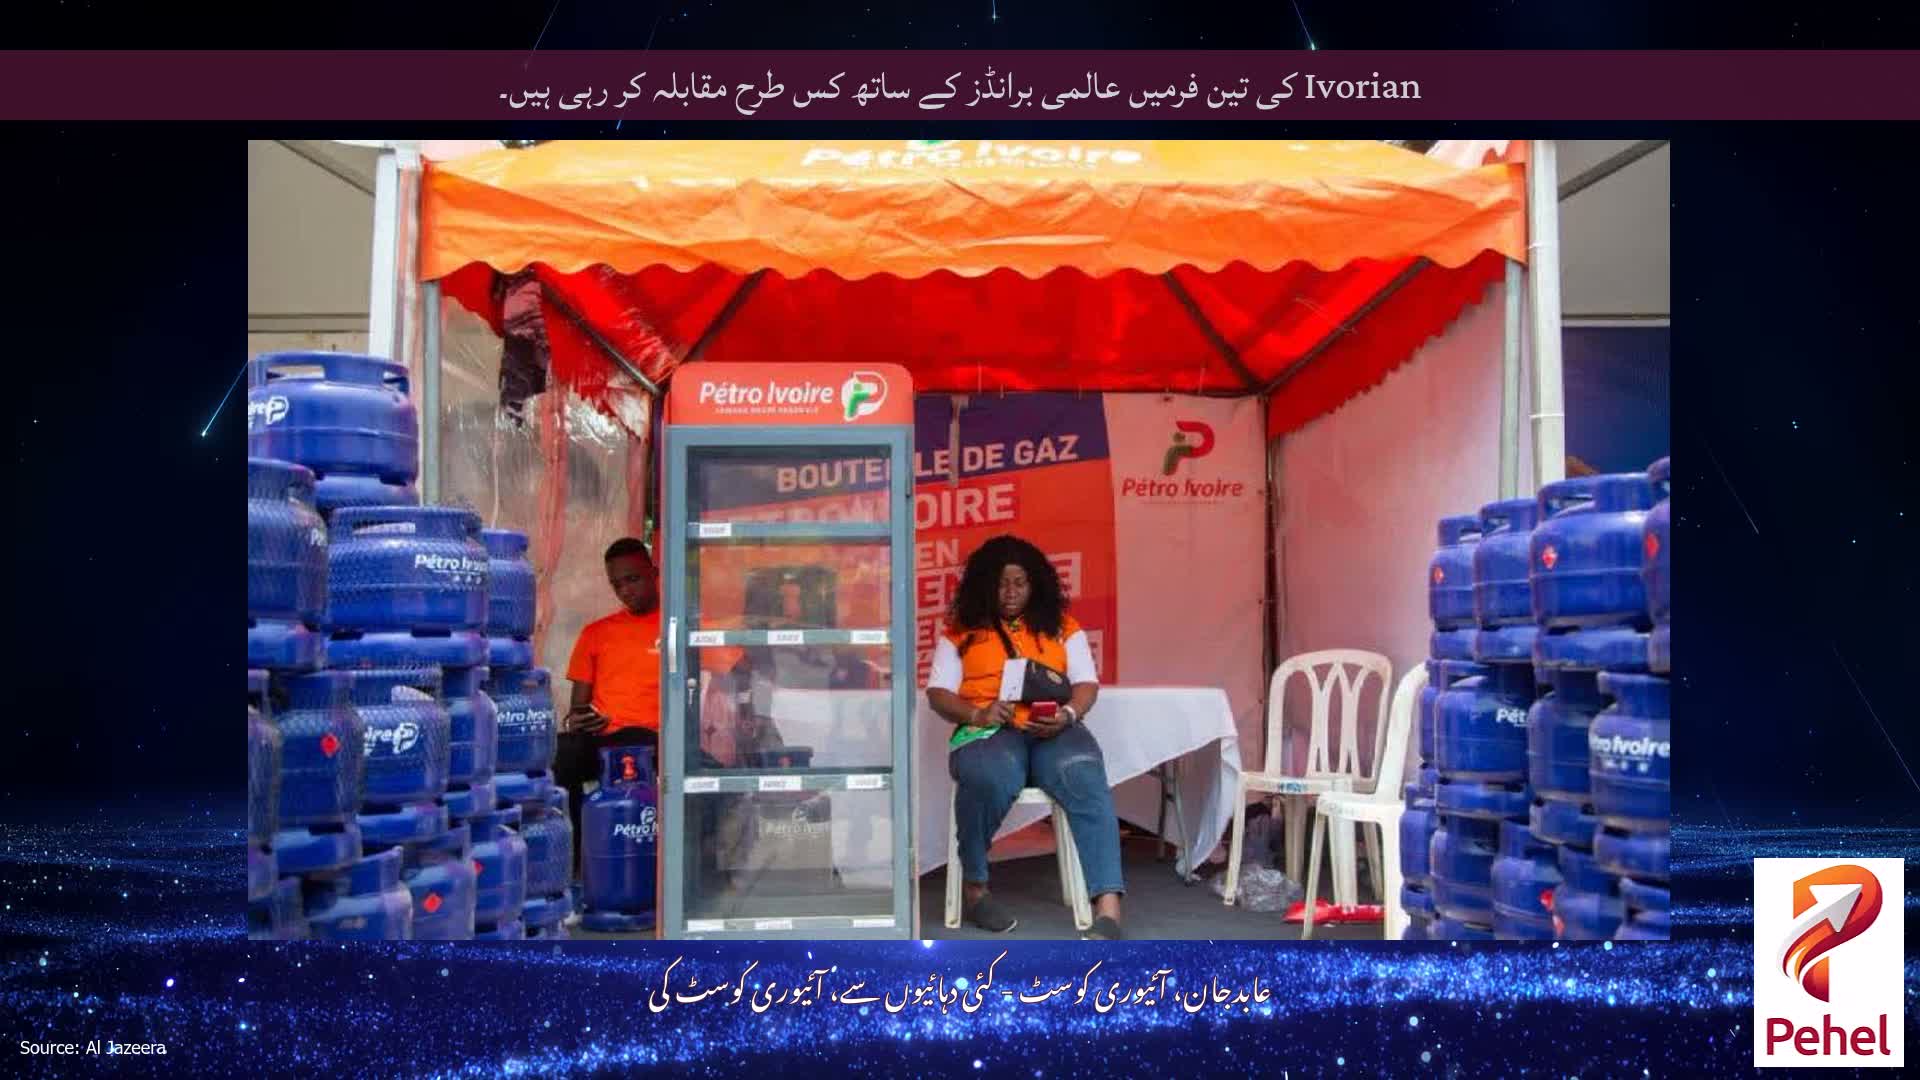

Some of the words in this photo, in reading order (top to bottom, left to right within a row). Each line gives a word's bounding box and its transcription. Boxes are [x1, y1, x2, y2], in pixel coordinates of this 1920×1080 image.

[700, 379, 763, 404] Pétro
[768, 381, 834, 404] Ivoire
[963, 443, 1005, 473] DE
[1014, 434, 1081, 466] GAZ
[1184, 477, 1244, 498] Ivoire
[1612, 735, 1670, 758] Ivoire
